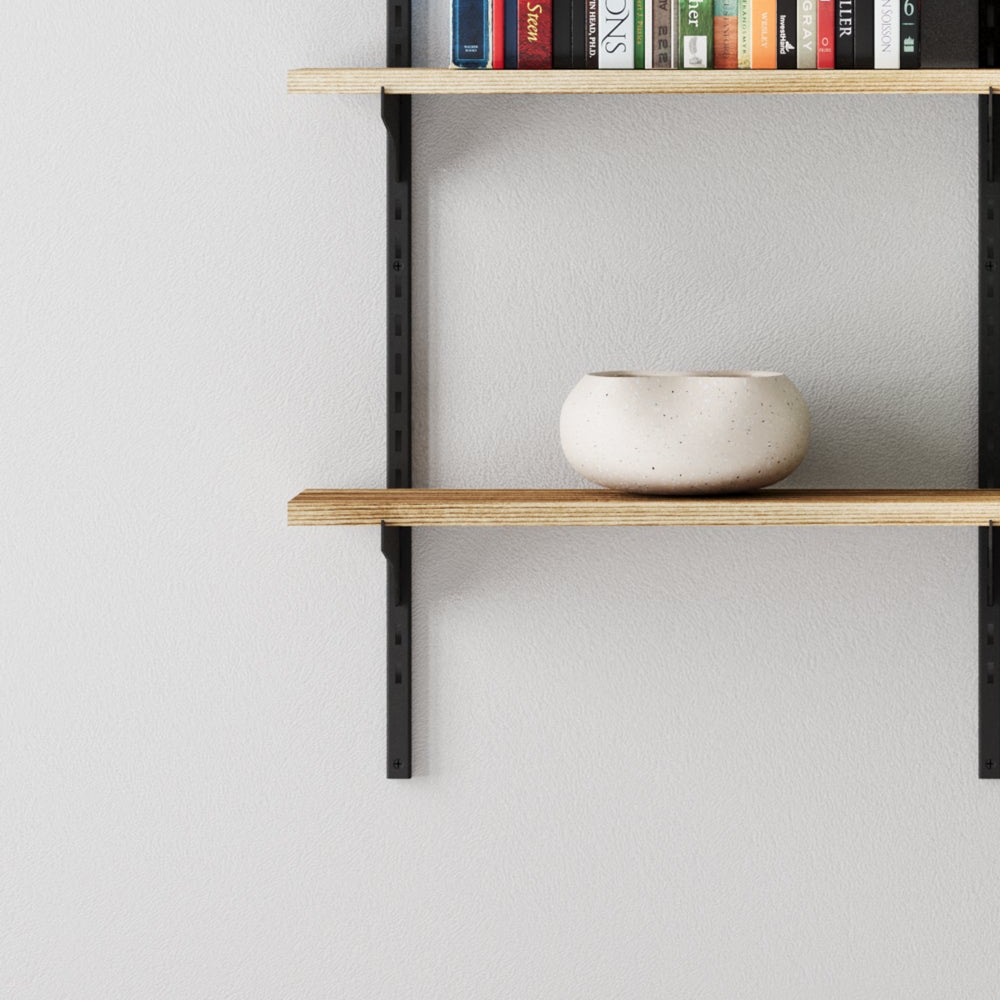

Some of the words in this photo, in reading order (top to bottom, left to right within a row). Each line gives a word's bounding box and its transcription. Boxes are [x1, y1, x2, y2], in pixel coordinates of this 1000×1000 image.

[526, 1, 543, 43] Steen
[588, 11, 596, 36] HEAD,
[760, 12, 768, 49] WESLEY
[802, 0, 812, 52] GRAY
[880, 9, 893, 53] SOISSON
